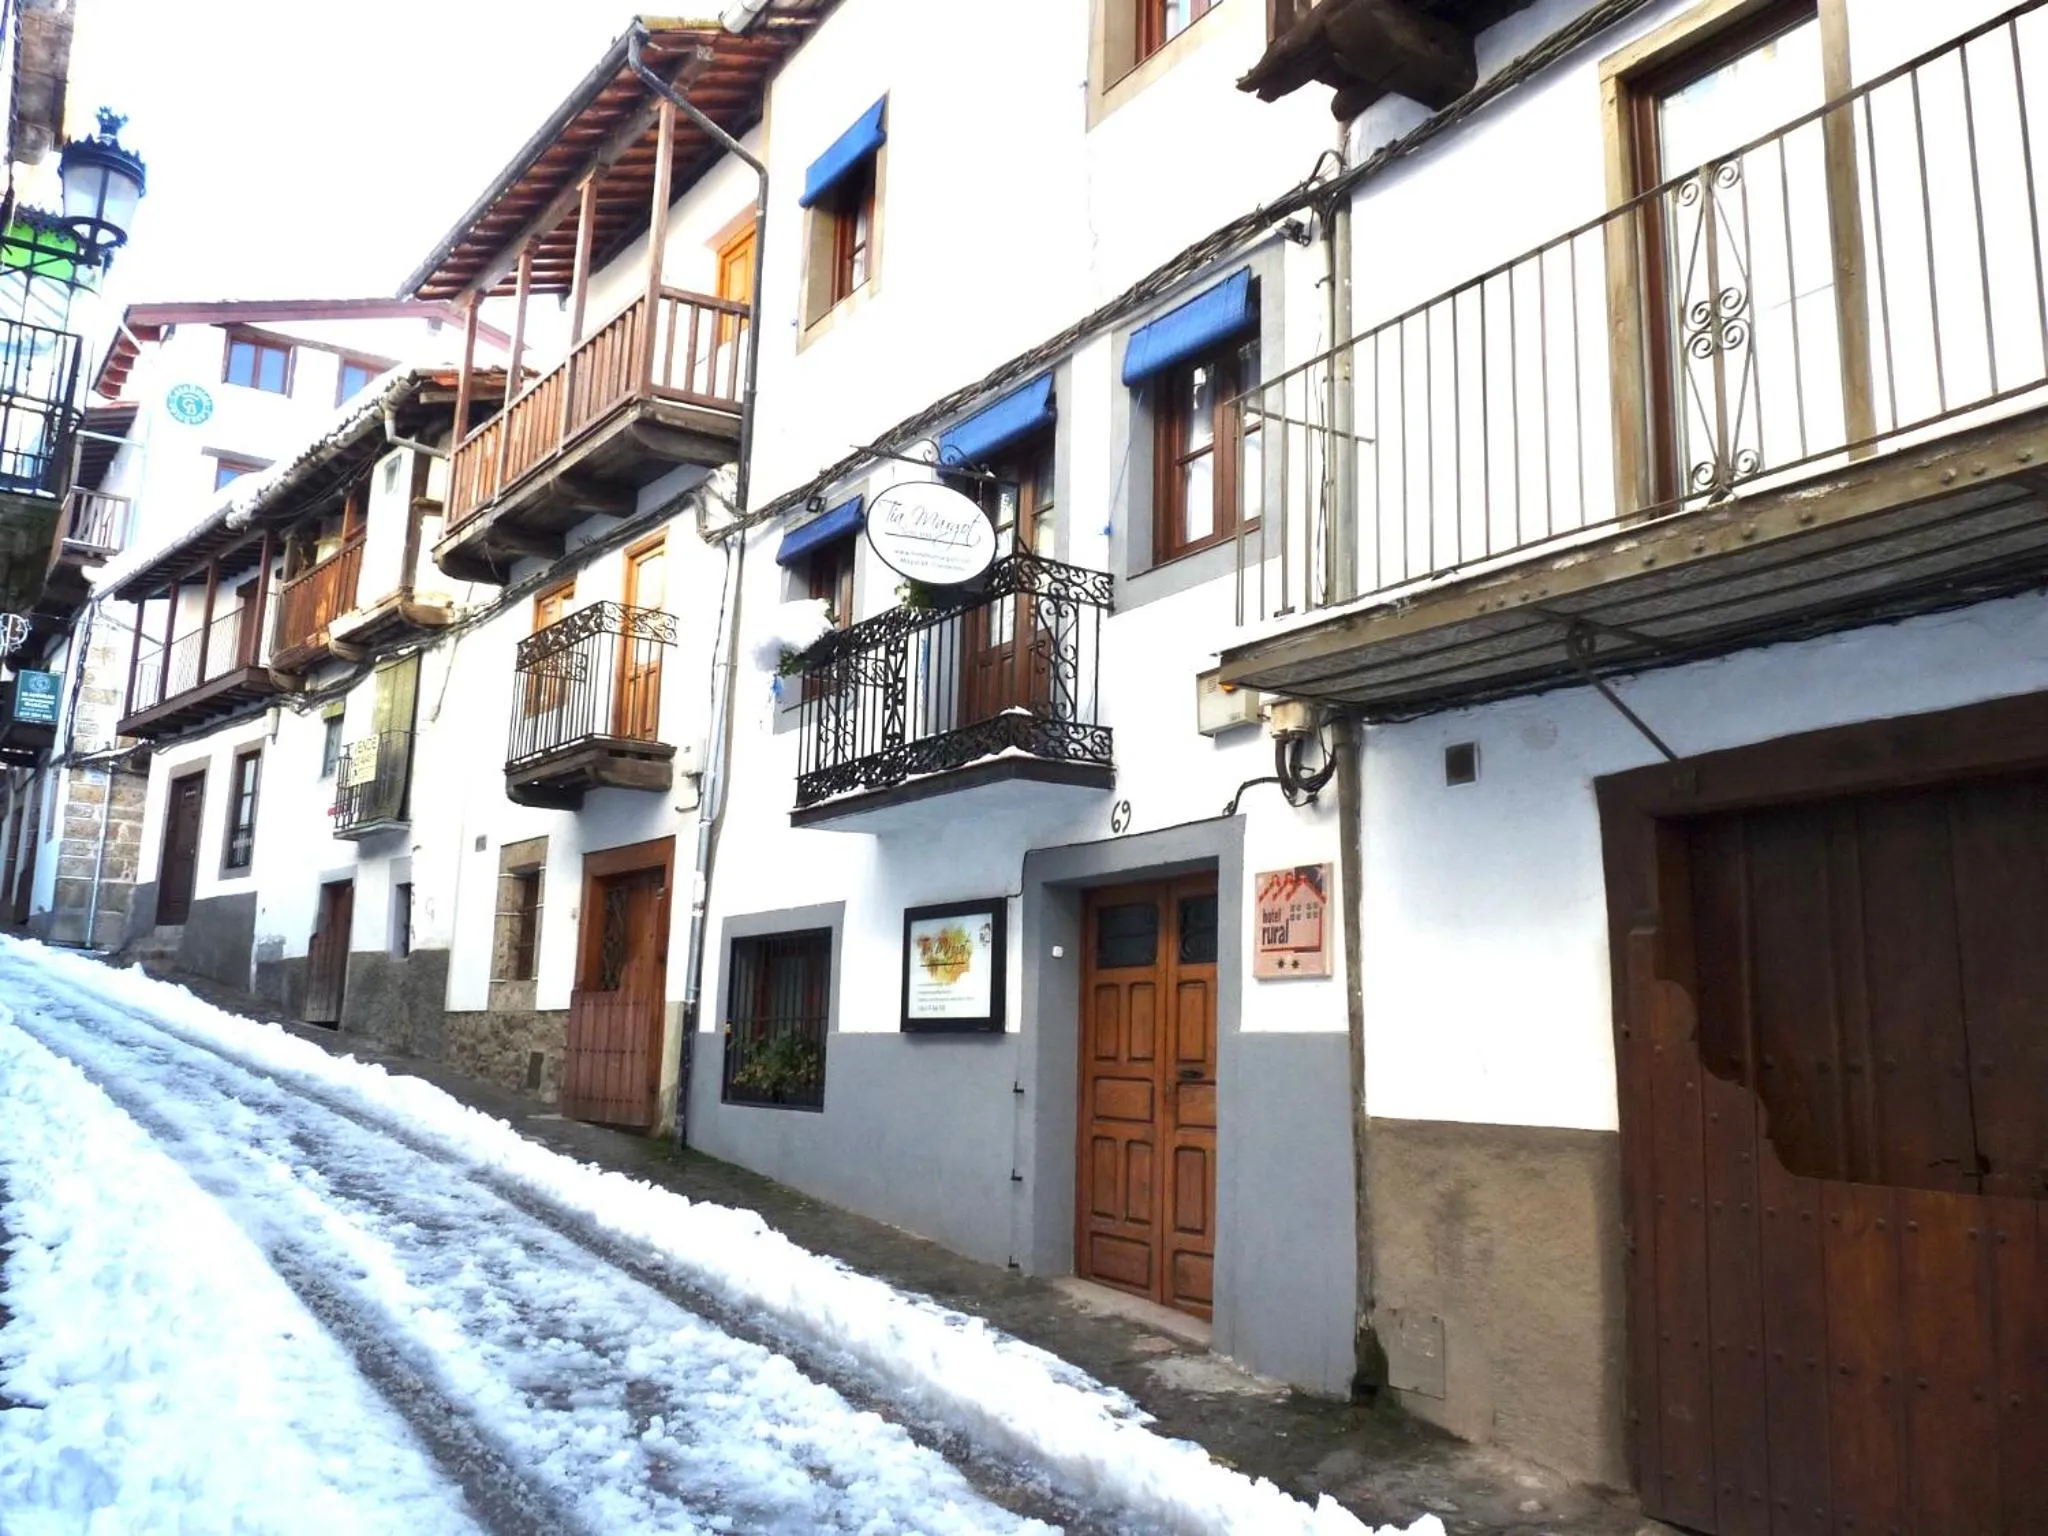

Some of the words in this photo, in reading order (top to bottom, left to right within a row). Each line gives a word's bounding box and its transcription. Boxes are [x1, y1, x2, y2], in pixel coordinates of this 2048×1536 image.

[911, 505, 981, 550] Margot
[1111, 799, 1131, 833] 69
[1263, 908, 1281, 923] hotel
[1263, 918, 1289, 945] rural
